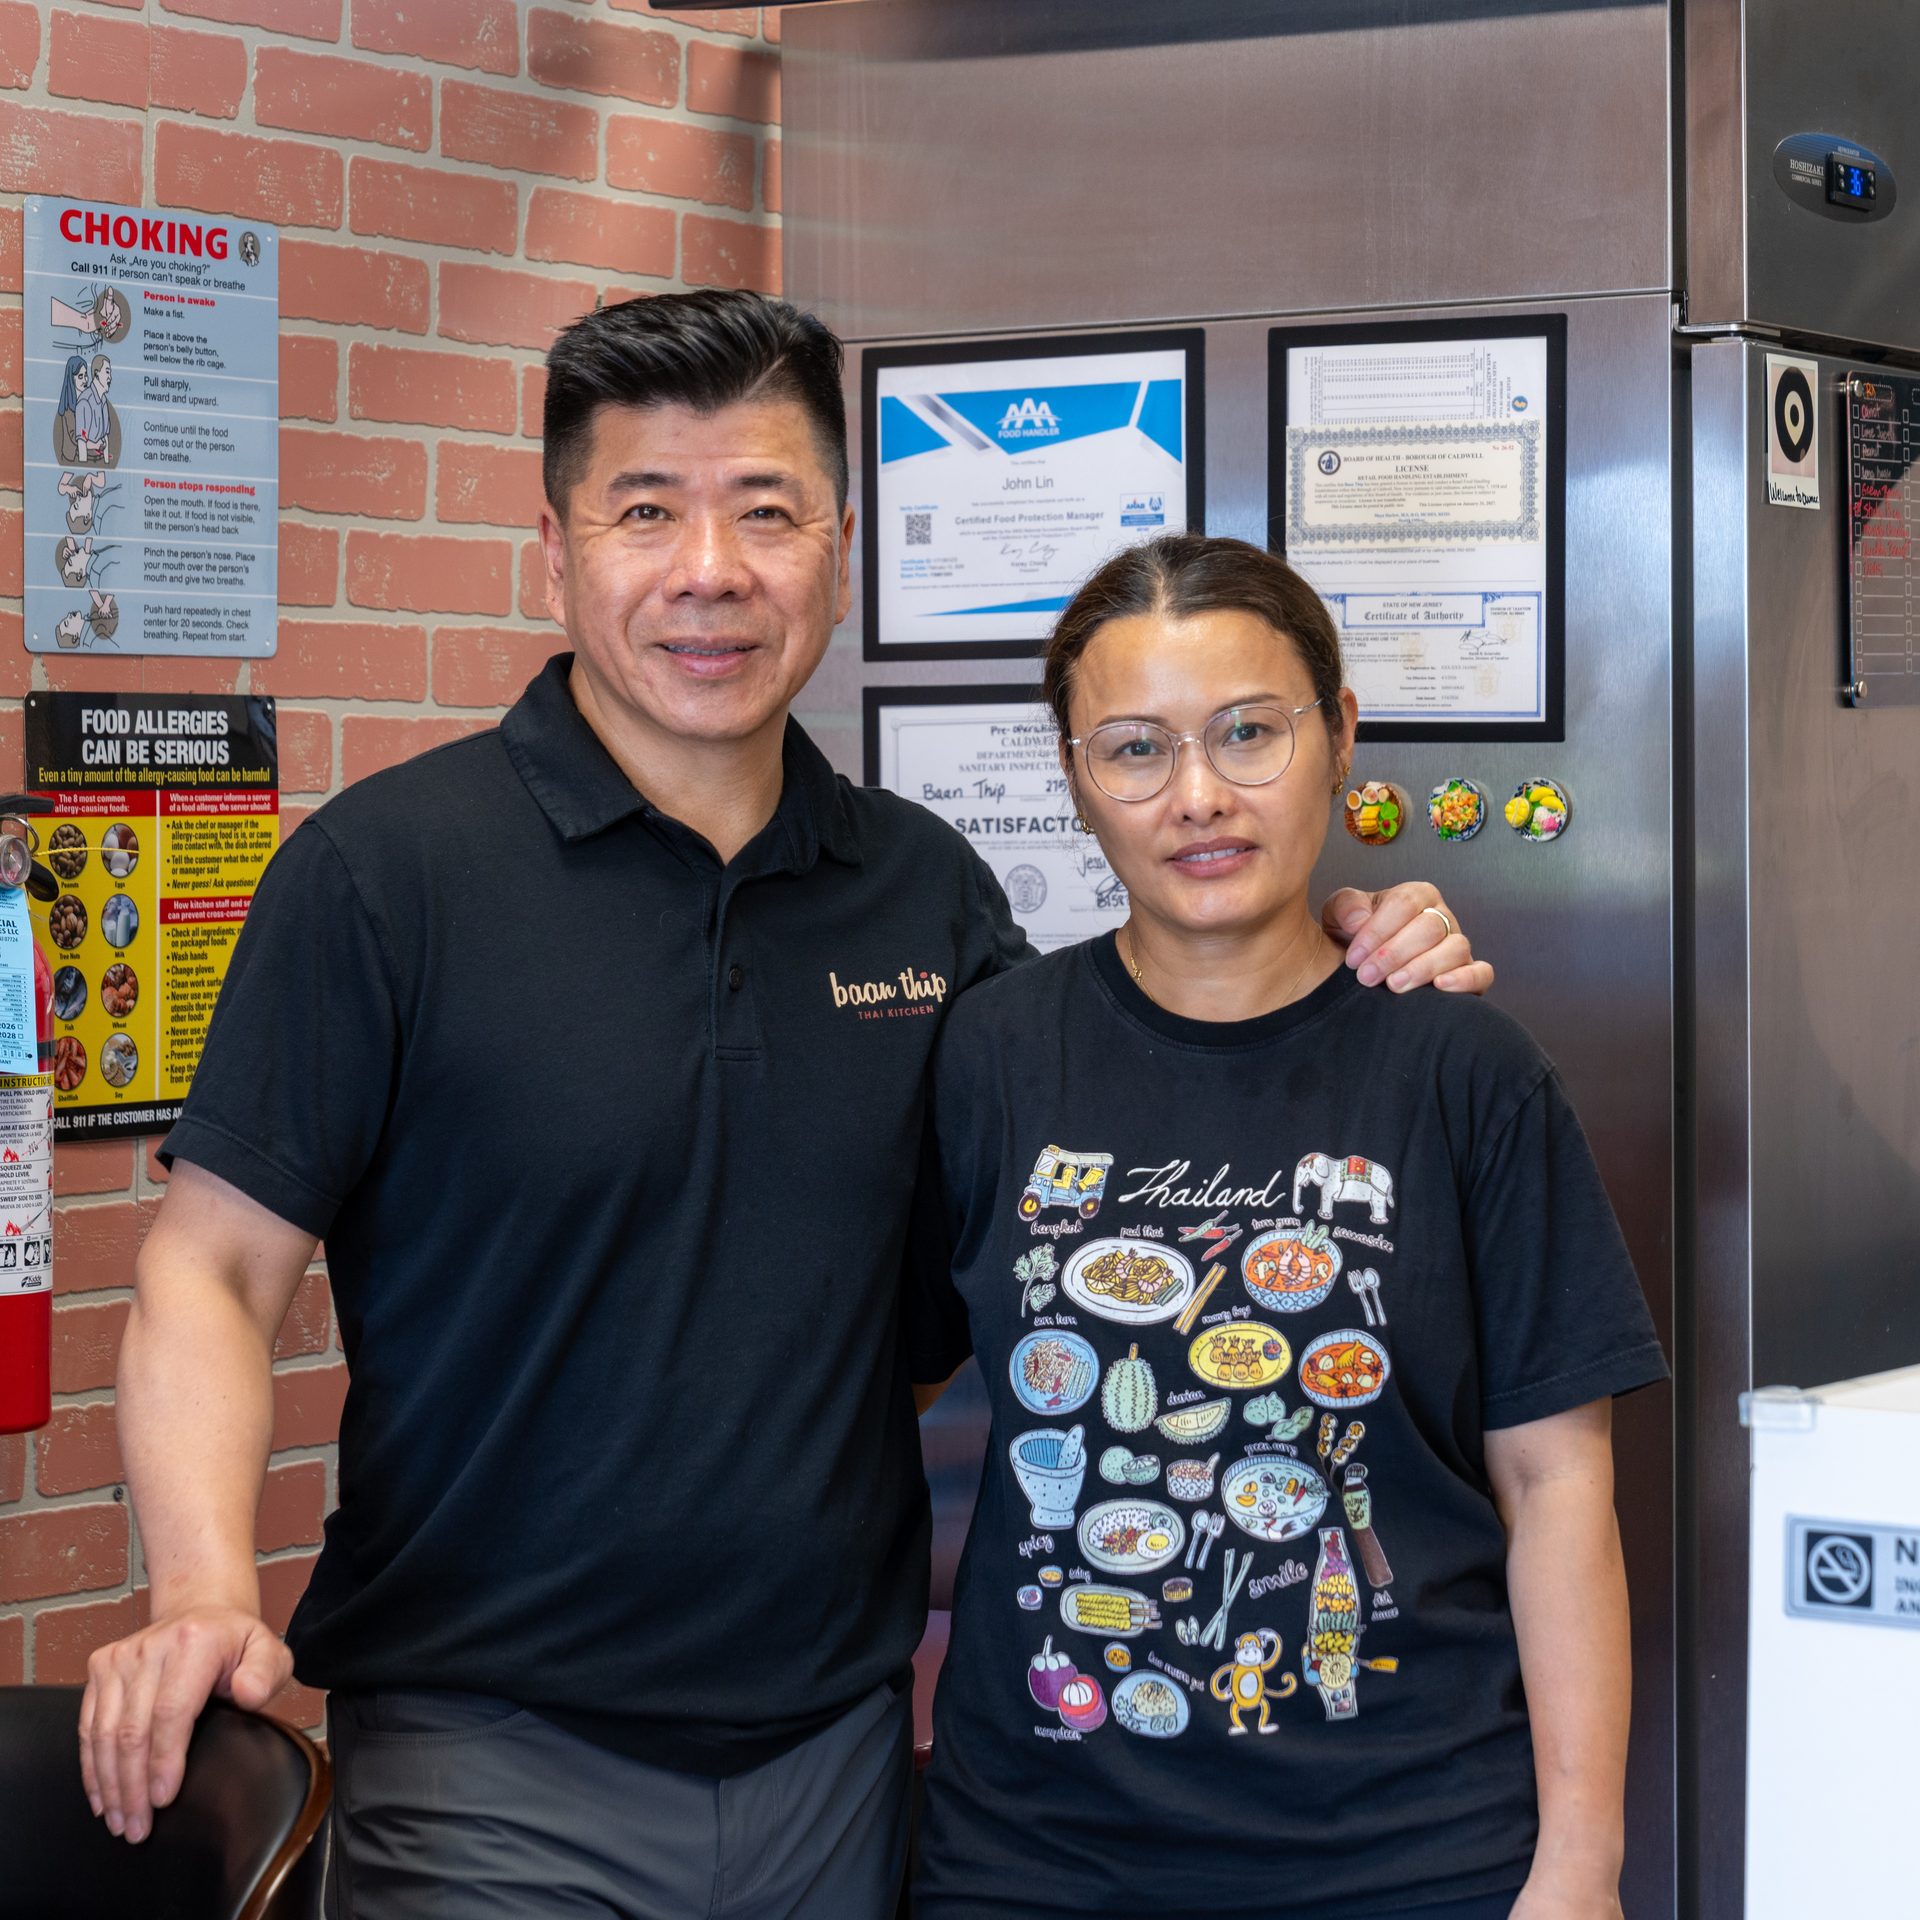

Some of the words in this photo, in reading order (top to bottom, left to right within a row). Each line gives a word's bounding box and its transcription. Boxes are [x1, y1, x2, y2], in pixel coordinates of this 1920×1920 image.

[1790, 159, 1824, 175] HOSHIZAKI
[59, 209, 228, 260] CHOKING
[109, 253, 127, 265] Ask
[150, 259, 166, 270] you
[70, 261, 90, 273] Call
[92, 264, 108, 275] 911
[111, 266, 117, 276] if
[119, 269, 150, 280] person
[151, 272, 173, 283] can't
[175, 275, 201, 286] speak
[202, 278, 212, 287] or
[213, 278, 245, 291] breathe
[143, 290, 175, 303] Person
[177, 294, 186, 304] is
[187, 297, 215, 307] awake
[143, 307, 164, 317] Make
[172, 309, 185, 319] fist.
[143, 376, 159, 387] Pull
[160, 378, 191, 391] sharply,
[143, 391, 170, 403] inward
[171, 394, 187, 404] and
[188, 396, 219, 407] upward.
[1001, 398, 1057, 429] AAA
[143, 421, 179, 434] Continue
[180, 425, 197, 435] until
[198, 425, 210, 437] the
[211, 426, 229, 438] food
[998, 428, 1022, 438] FOOD
[1022, 427, 1060, 437] HANDLER
[143, 437, 170, 448] comes
[171, 439, 184, 448] out
[185, 440, 194, 449] or
[195, 440, 207, 450] the
[209, 442, 235, 453] person
[143, 451, 158, 460] can
[159, 451, 191, 463] breathe.
[1395, 464, 1428, 472] LICENSE
[143, 478, 176, 489] Person
[178, 480, 204, 492] stops
[205, 484, 255, 497] responding
[1001, 477, 1032, 491] John
[1035, 475, 1054, 489] Lin
[954, 515, 992, 526] Certified
[993, 514, 1016, 523] Food
[1017, 513, 1064, 522] Protection
[1066, 511, 1104, 521] Manager
[143, 604, 163, 614] Push
[164, 605, 182, 615] hard
[183, 607, 222, 618] repeatedly
[223, 607, 230, 616] in
[231, 608, 251, 617] chest
[1364, 611, 1407, 621] Certificate
[1411, 611, 1419, 620] of
[1423, 611, 1464, 620] Authority
[81, 709, 130, 734] FOOD
[134, 709, 228, 735] ALLERGIES
[82, 739, 121, 764] CAN
[126, 739, 150, 764] BE
[154, 739, 229, 765] SERIOUS
[976, 750, 1036, 760] DEPARTMENT
[958, 763, 1005, 772] SANITARY
[38, 766, 59, 783] Even
[60, 770, 66, 783] a
[67, 767, 83, 786] tiny
[84, 769, 114, 783] amount
[114, 766, 123, 782] of
[123, 767, 137, 782] the
[138, 767, 197, 786] allergy-causing
[197, 766, 215, 782] food
[215, 770, 230, 782] can
[231, 767, 241, 782] be
[242, 767, 270, 782] harmful
[972, 778, 1006, 804] Thip
[58, 793, 72, 805] The
[73, 793, 78, 803] 8
[78, 794, 96, 803] most
[96, 795, 126, 806] common
[54, 803, 108, 815] allergy-causing
[109, 803, 129, 812] foods:
[829, 972, 897, 1008] baan
[898, 967, 947, 1002] thip
[858, 1009, 883, 1020] THAI
[887, 1004, 934, 1017] KITCHEN
[72, 1115, 86, 1128] 911
[87, 1114, 96, 1127] IF
[96, 1112, 112, 1126] THE
[113, 1109, 155, 1125] CUSTOMER
[155, 1107, 172, 1121] HAS
[1118, 1159, 1287, 1208] Thailand
[1031, 1218, 1084, 1239] bangkok
[1120, 1224, 1141, 1239] pad
[1142, 1224, 1164, 1238] thai
[1167, 1389, 1206, 1406] durian
[1248, 1559, 1310, 1600] smile
